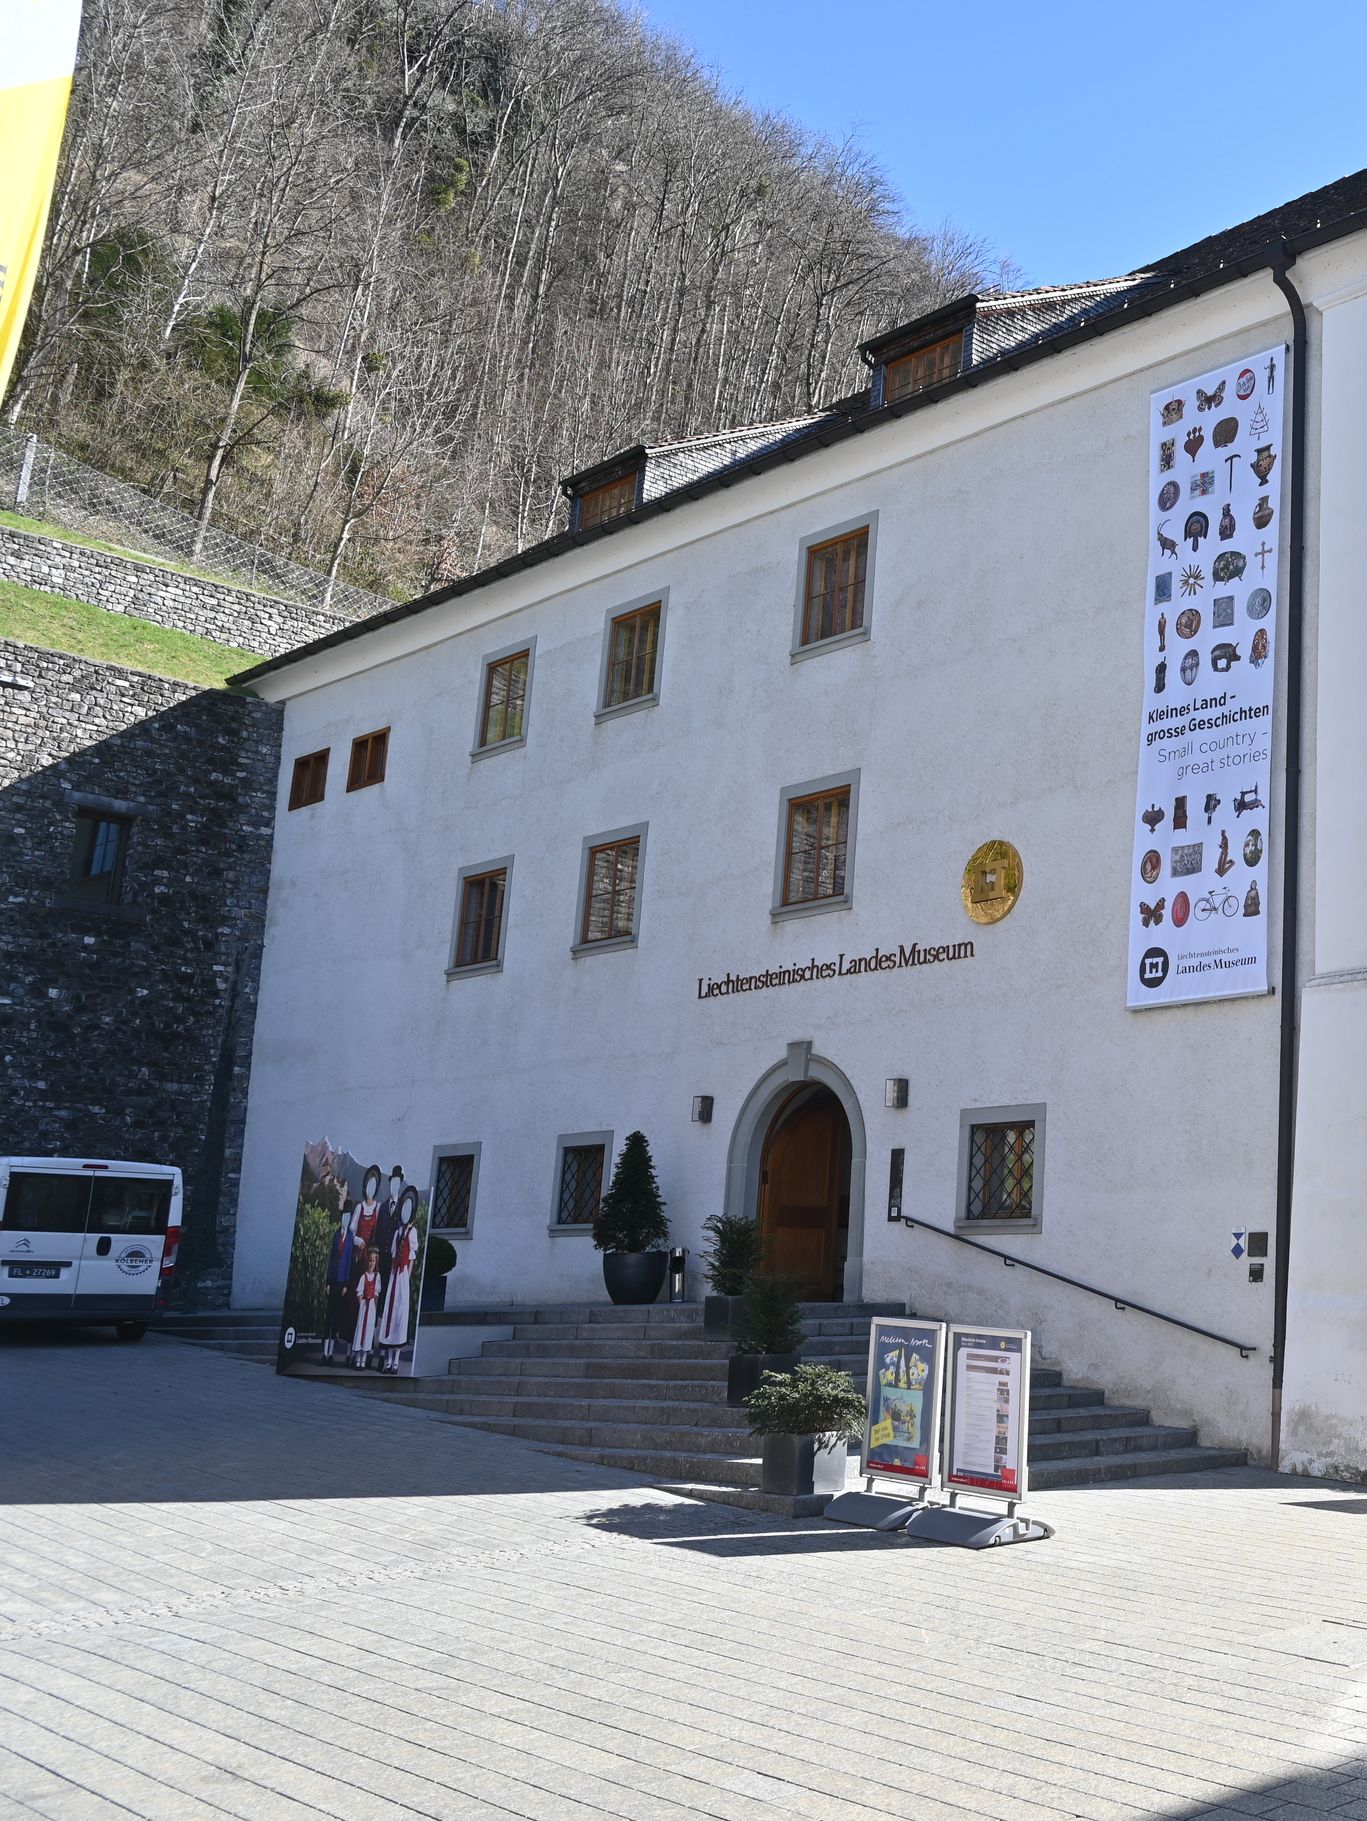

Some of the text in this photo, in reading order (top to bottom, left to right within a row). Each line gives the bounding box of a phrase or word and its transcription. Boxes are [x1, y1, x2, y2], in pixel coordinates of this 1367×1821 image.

[1148, 703, 1191, 724] Kleines
[1193, 692, 1227, 712] Land
[1146, 704, 1270, 746] grosse Geschichten
[1157, 740, 1194, 763] Small
[1199, 730, 1257, 754] country
[1177, 748, 1268, 781] great stories
[1177, 945, 1240, 961] Liechtensteinisches
[697, 957, 836, 999] Liechtensteinisches
[13, 1268, 24, 1276] FL
